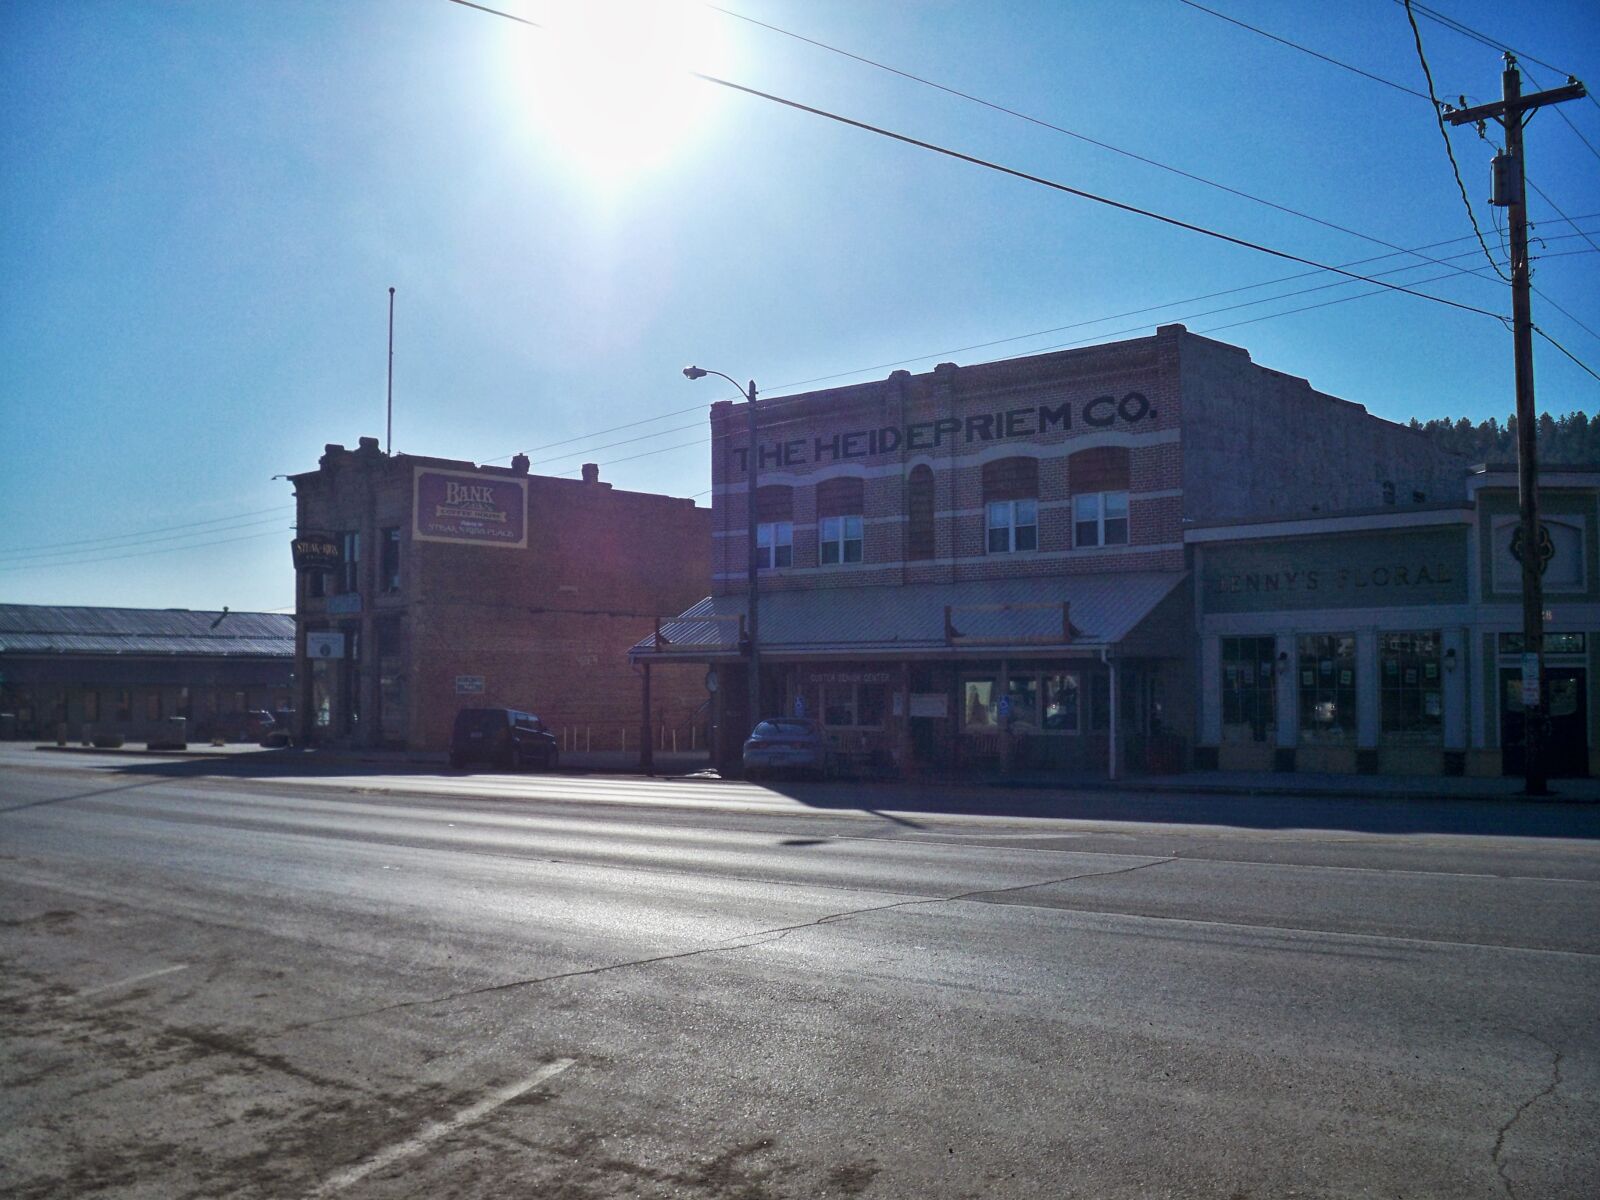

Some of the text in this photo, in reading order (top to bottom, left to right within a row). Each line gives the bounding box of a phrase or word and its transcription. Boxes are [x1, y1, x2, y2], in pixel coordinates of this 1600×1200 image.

[732, 391, 1158, 472] THE HEIDEPRIEM CO.
[445, 481, 495, 504] BANK
[1338, 563, 1453, 589] FLORAL
